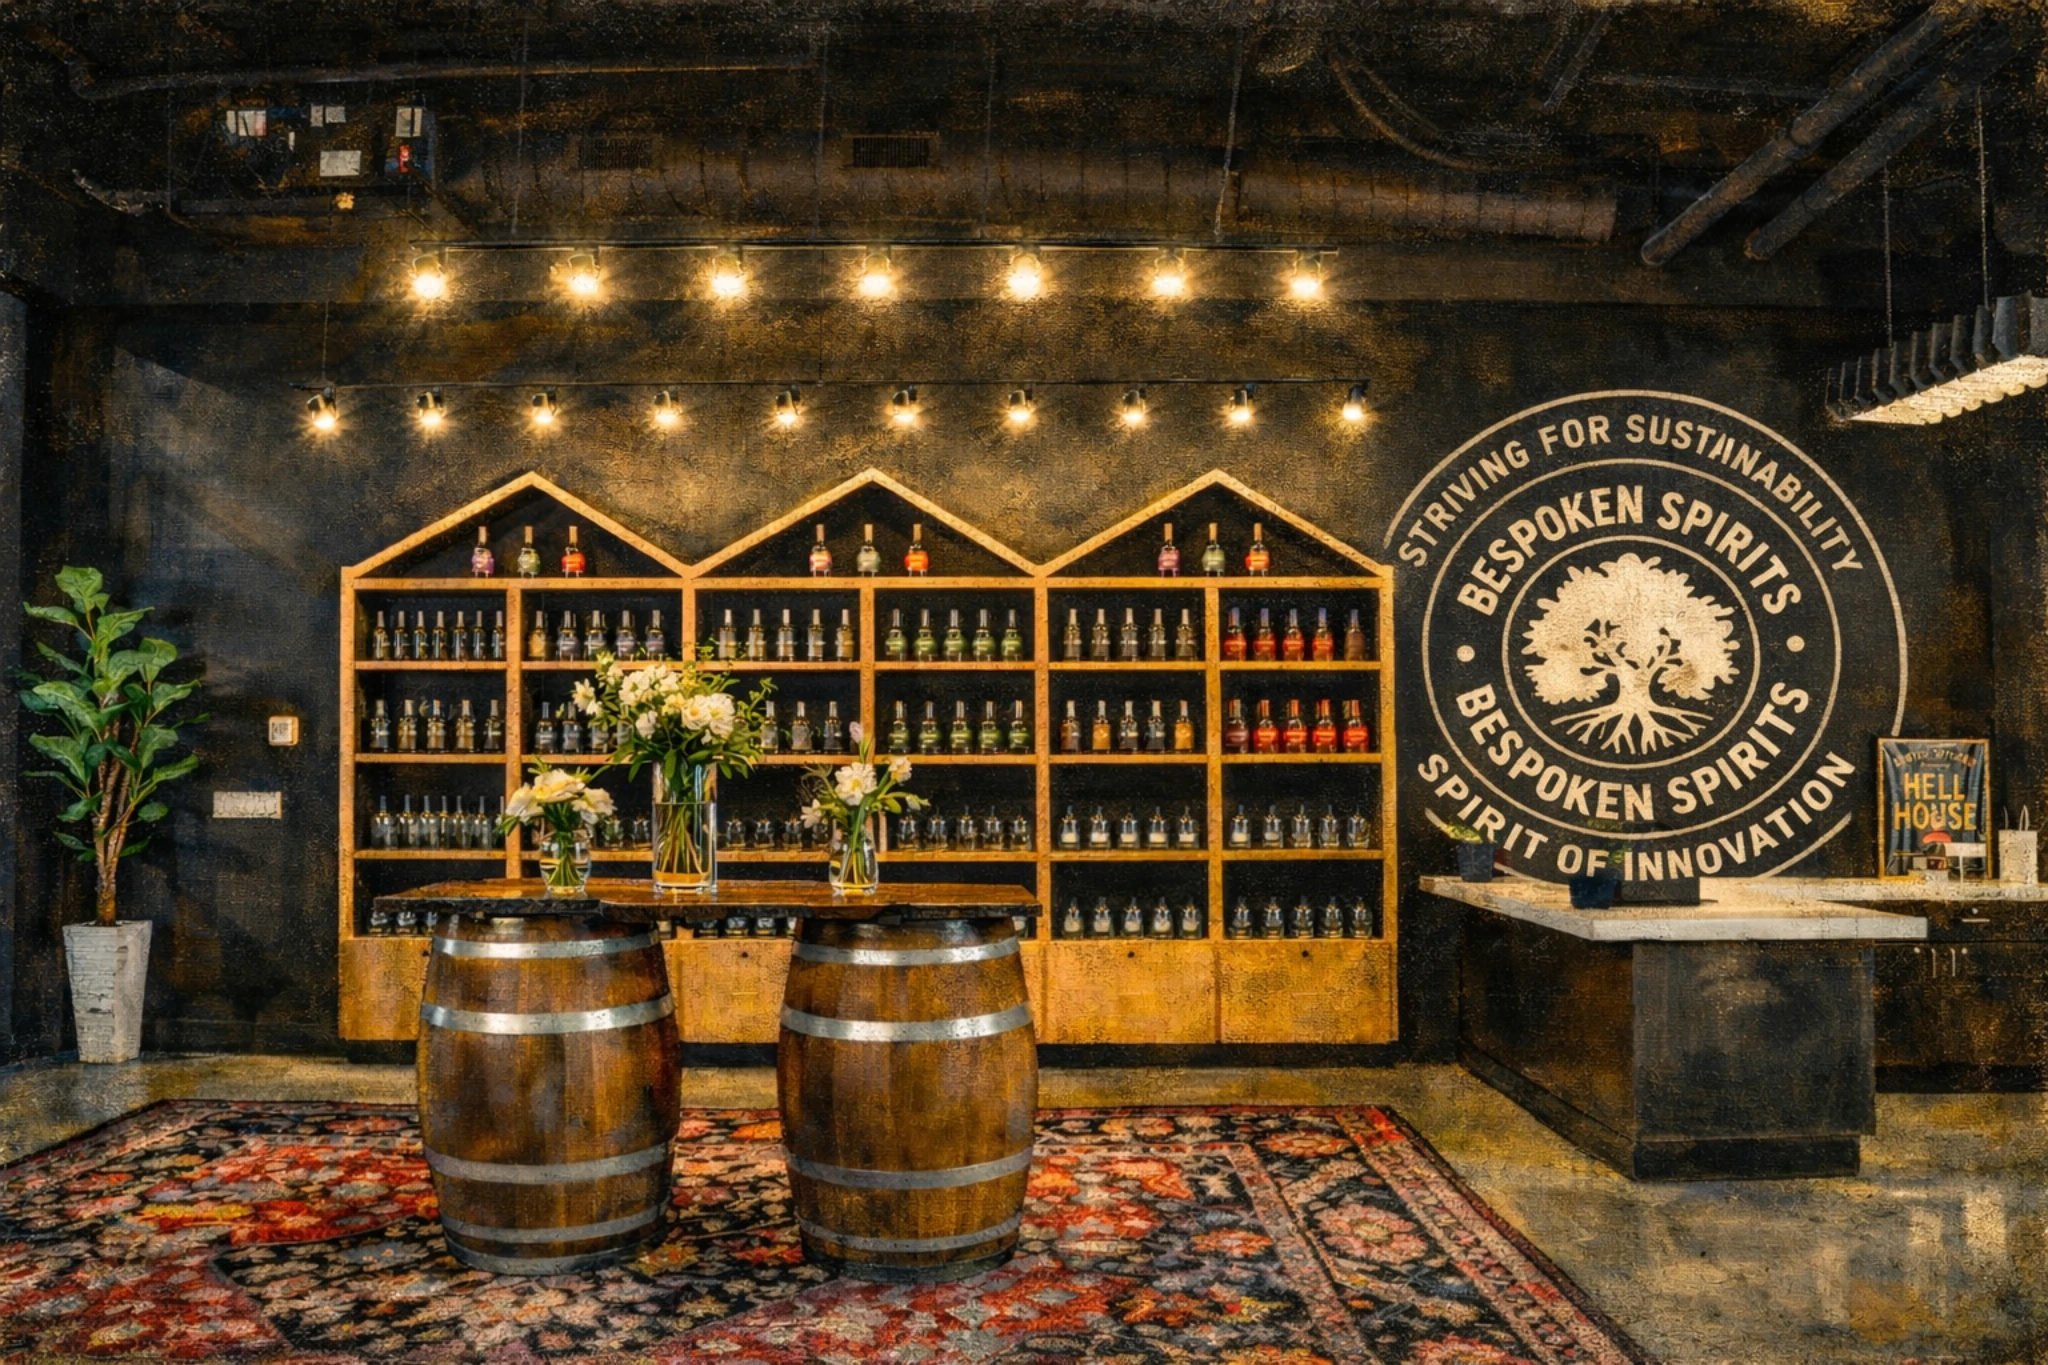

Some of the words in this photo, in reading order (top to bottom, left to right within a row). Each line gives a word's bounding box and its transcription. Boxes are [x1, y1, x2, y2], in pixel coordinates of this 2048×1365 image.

[1399, 438, 1530, 568] STRIVING
[1539, 415, 1612, 456] FOR
[1456, 484, 1644, 617] BESPOKEN
[1656, 491, 1802, 614] SPIRITS
[1418, 753, 1549, 860] SPIRIT
[1556, 843, 1609, 878] OF
[1623, 751, 1857, 882] INNOVATION
[1455, 683, 1652, 822] BESPOKEN
[1671, 681, 1810, 815] SPIRITS
[1893, 801, 1977, 831] HOUSE
[1903, 772, 1965, 800] HELL
